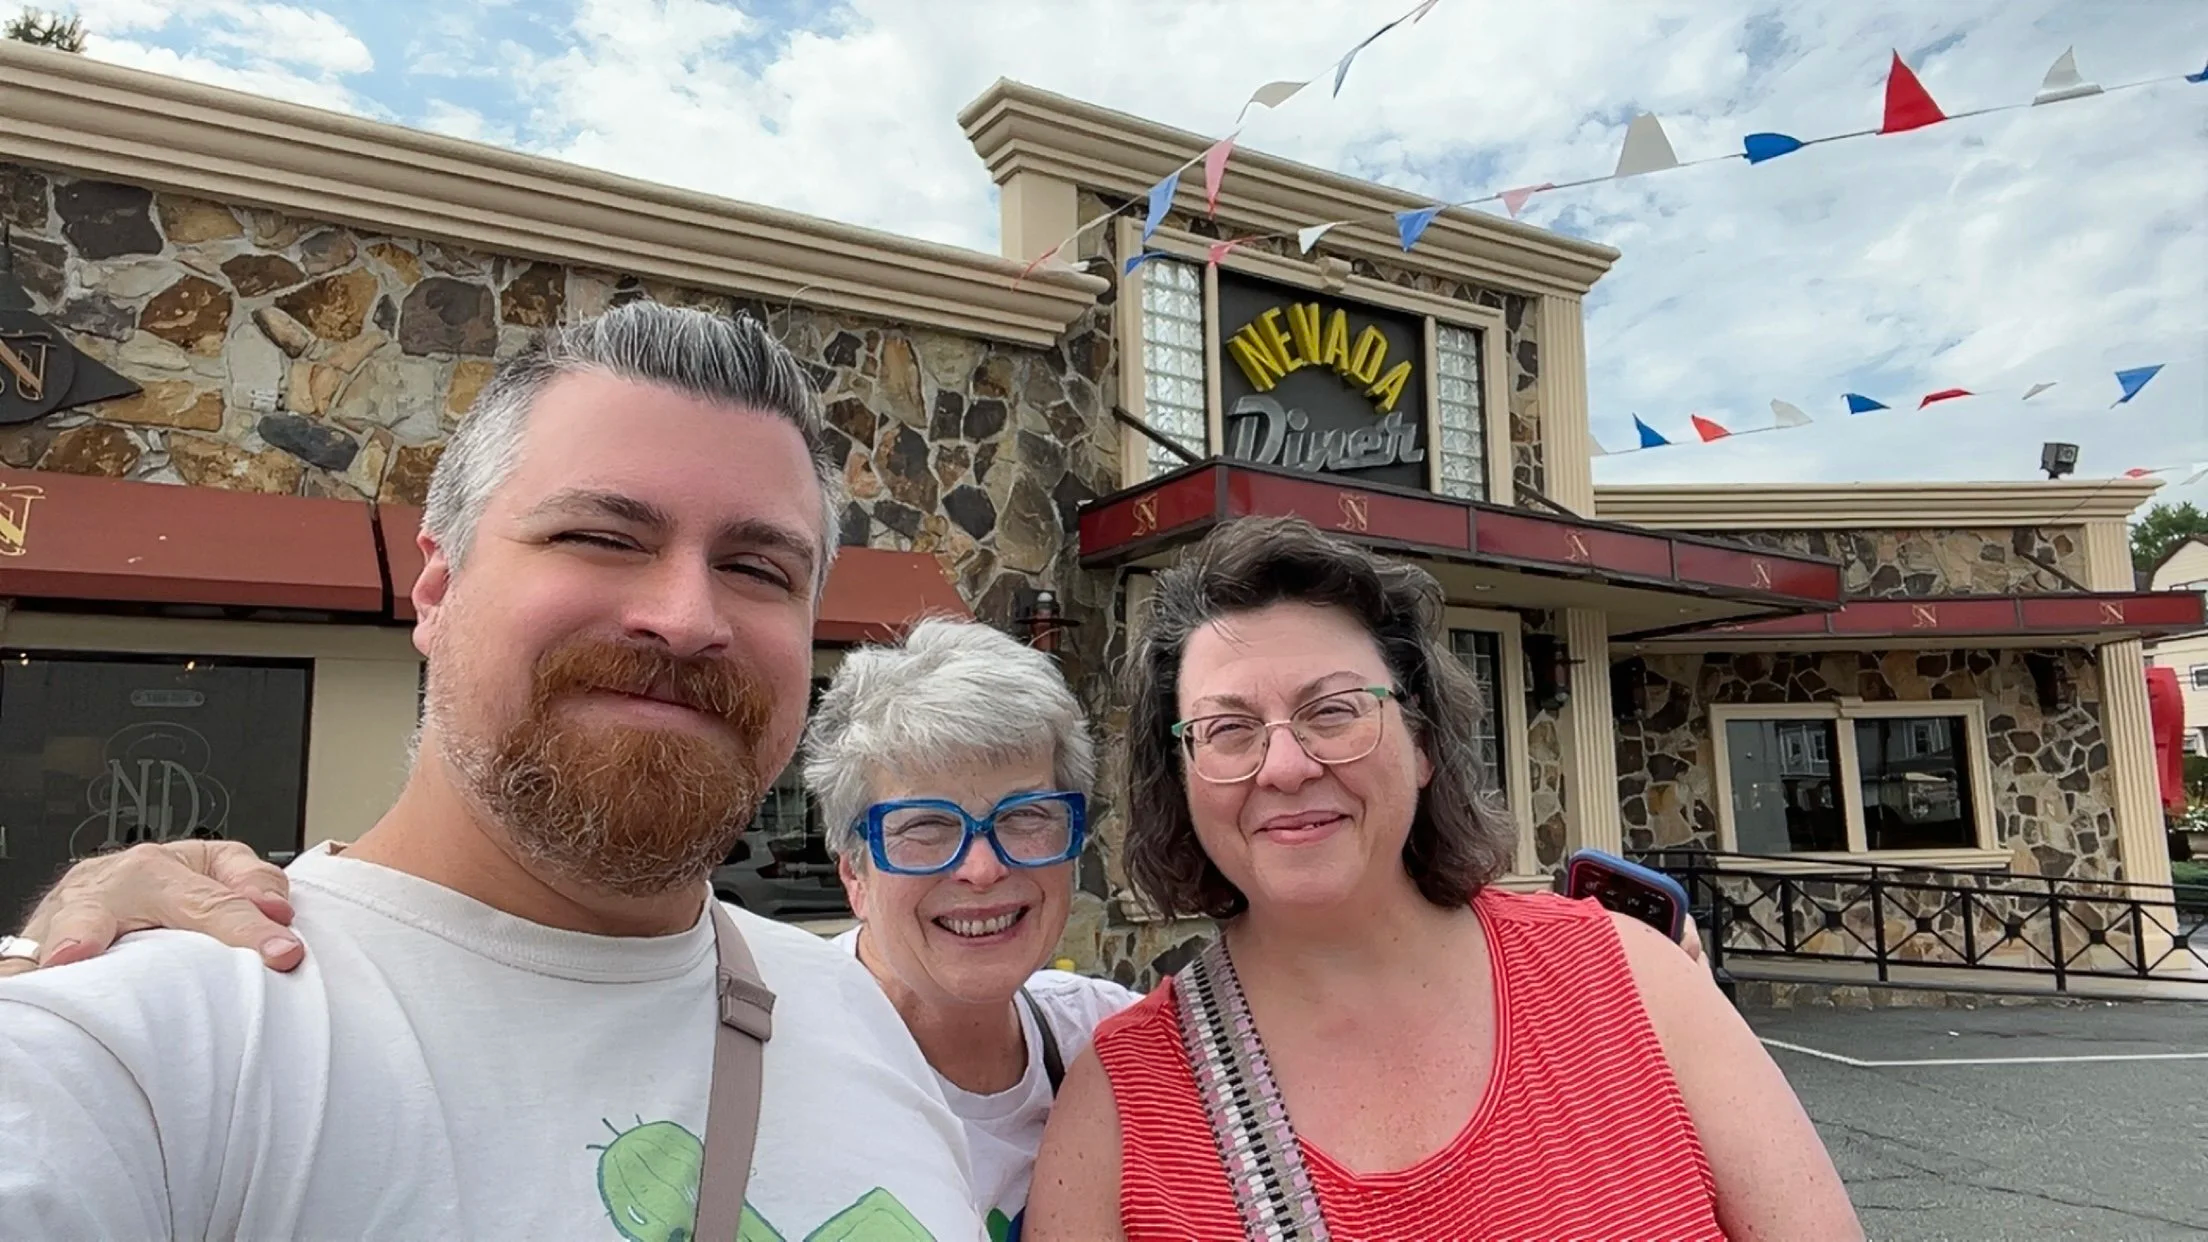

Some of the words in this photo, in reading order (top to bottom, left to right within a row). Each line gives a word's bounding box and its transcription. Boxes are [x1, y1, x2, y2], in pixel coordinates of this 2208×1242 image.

[1225, 302, 1412, 412] NEVADA
[1228, 395, 1424, 472] Diner
[108, 759, 200, 843] ND
